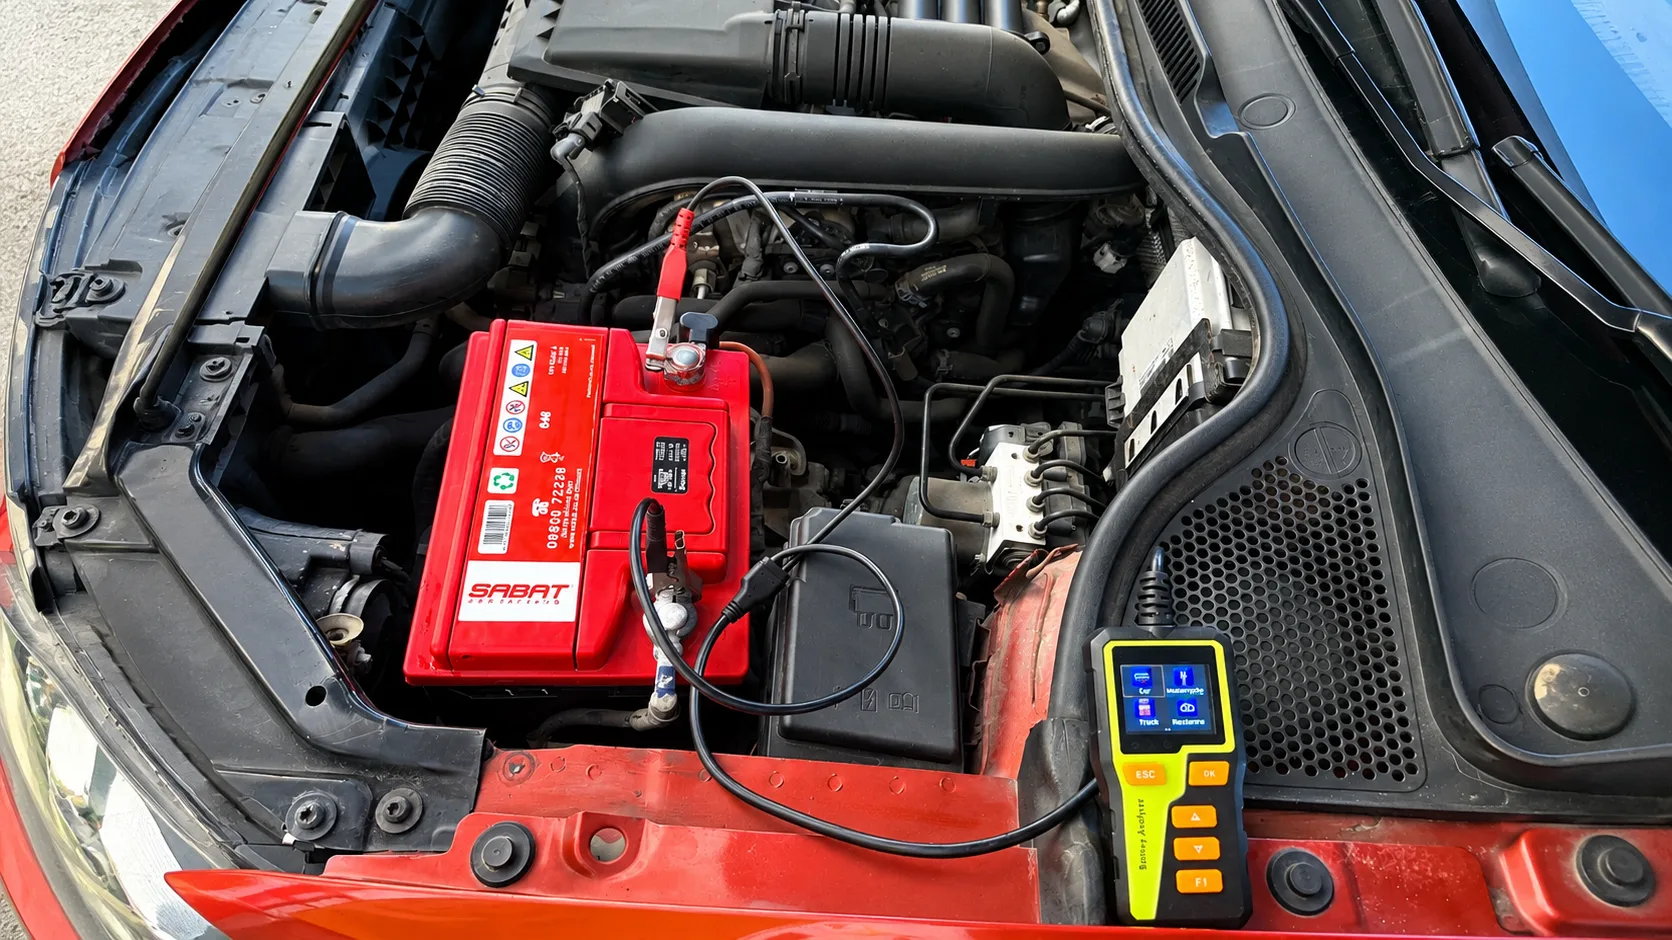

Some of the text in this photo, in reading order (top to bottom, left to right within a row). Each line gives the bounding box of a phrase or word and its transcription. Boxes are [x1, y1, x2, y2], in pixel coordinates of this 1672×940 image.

[468, 583, 570, 599] SABAT
[1138, 718, 1160, 726] Truck
[1135, 769, 1156, 779] ESC
[1203, 770, 1216, 778] OK
[1195, 877, 1208, 887] F1
